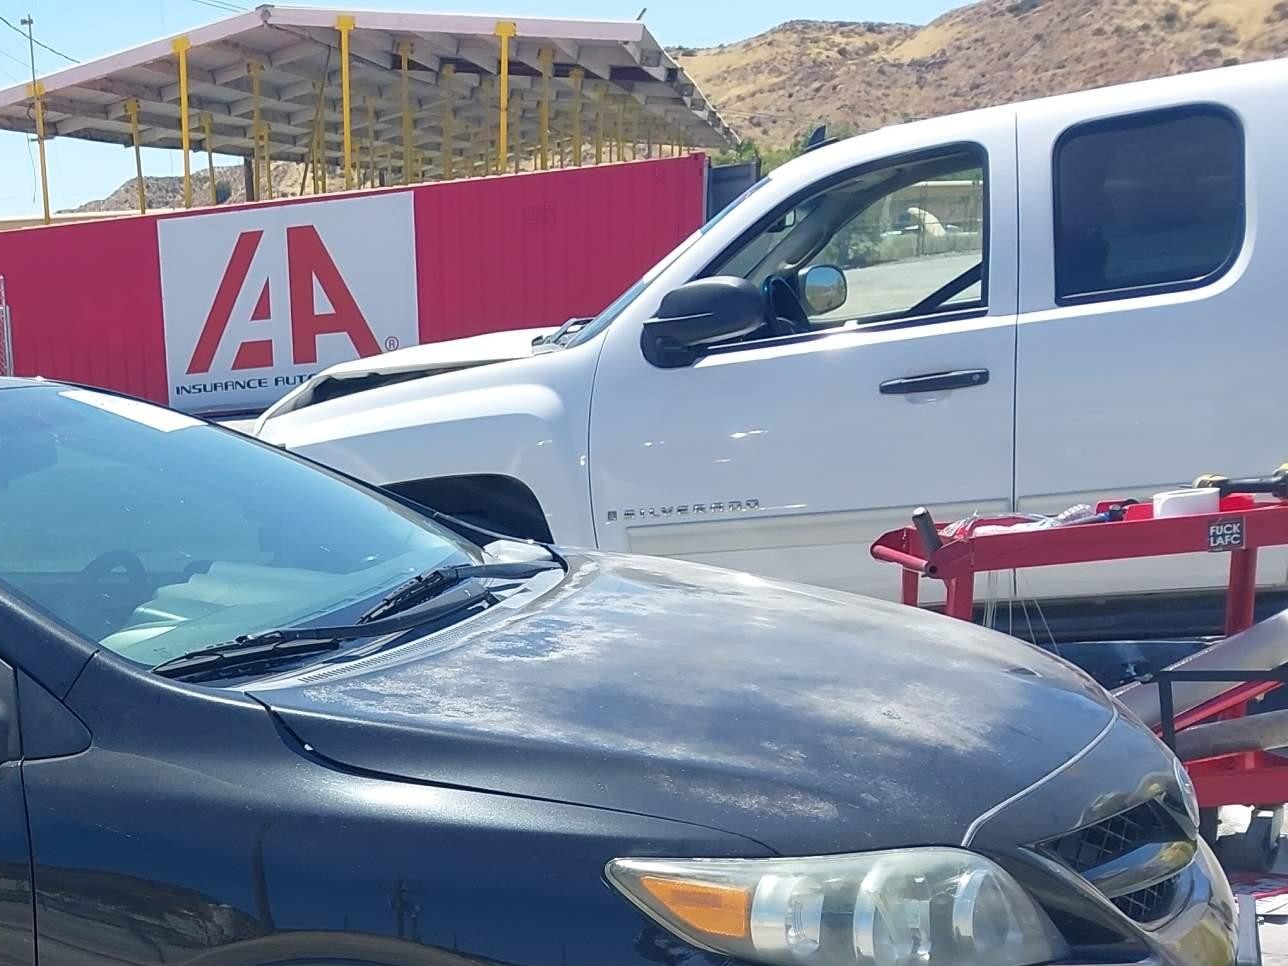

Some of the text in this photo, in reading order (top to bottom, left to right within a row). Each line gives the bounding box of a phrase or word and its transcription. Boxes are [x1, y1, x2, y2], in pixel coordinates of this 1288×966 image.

[176, 378, 268, 395] INSURANCE
[623, 499, 760, 520] SILVERADO
[1209, 523, 1241, 536] FUCK
[1210, 534, 1241, 547] LAFC
